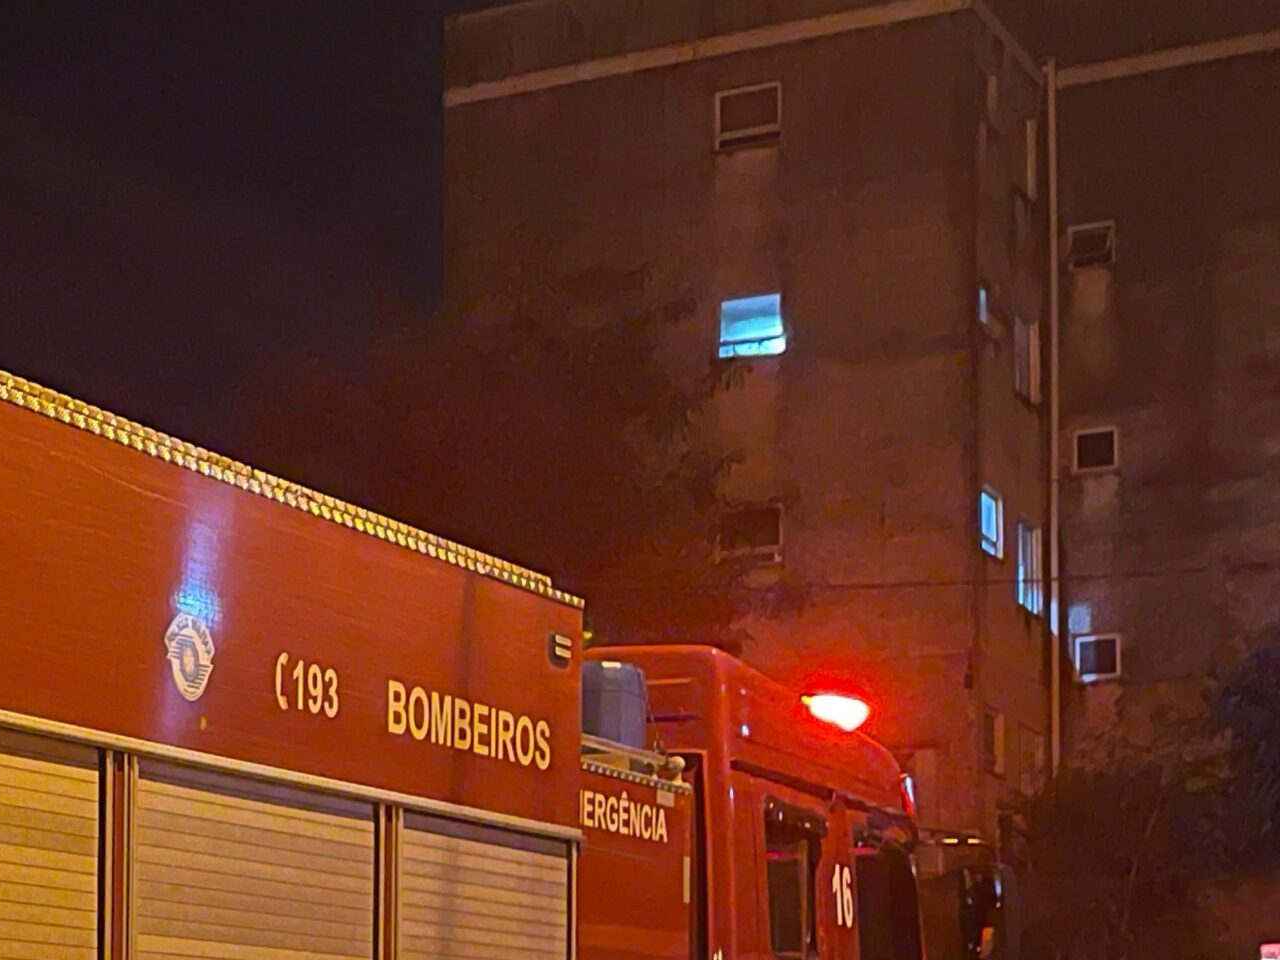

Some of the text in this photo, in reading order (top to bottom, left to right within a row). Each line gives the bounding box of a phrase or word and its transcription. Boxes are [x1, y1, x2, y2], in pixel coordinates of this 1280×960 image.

[293, 659, 339, 718] 193
[387, 679, 551, 770] BOMBEIROS
[580, 789, 668, 843] ERGÊNCIA
[832, 863, 854, 929] 16
